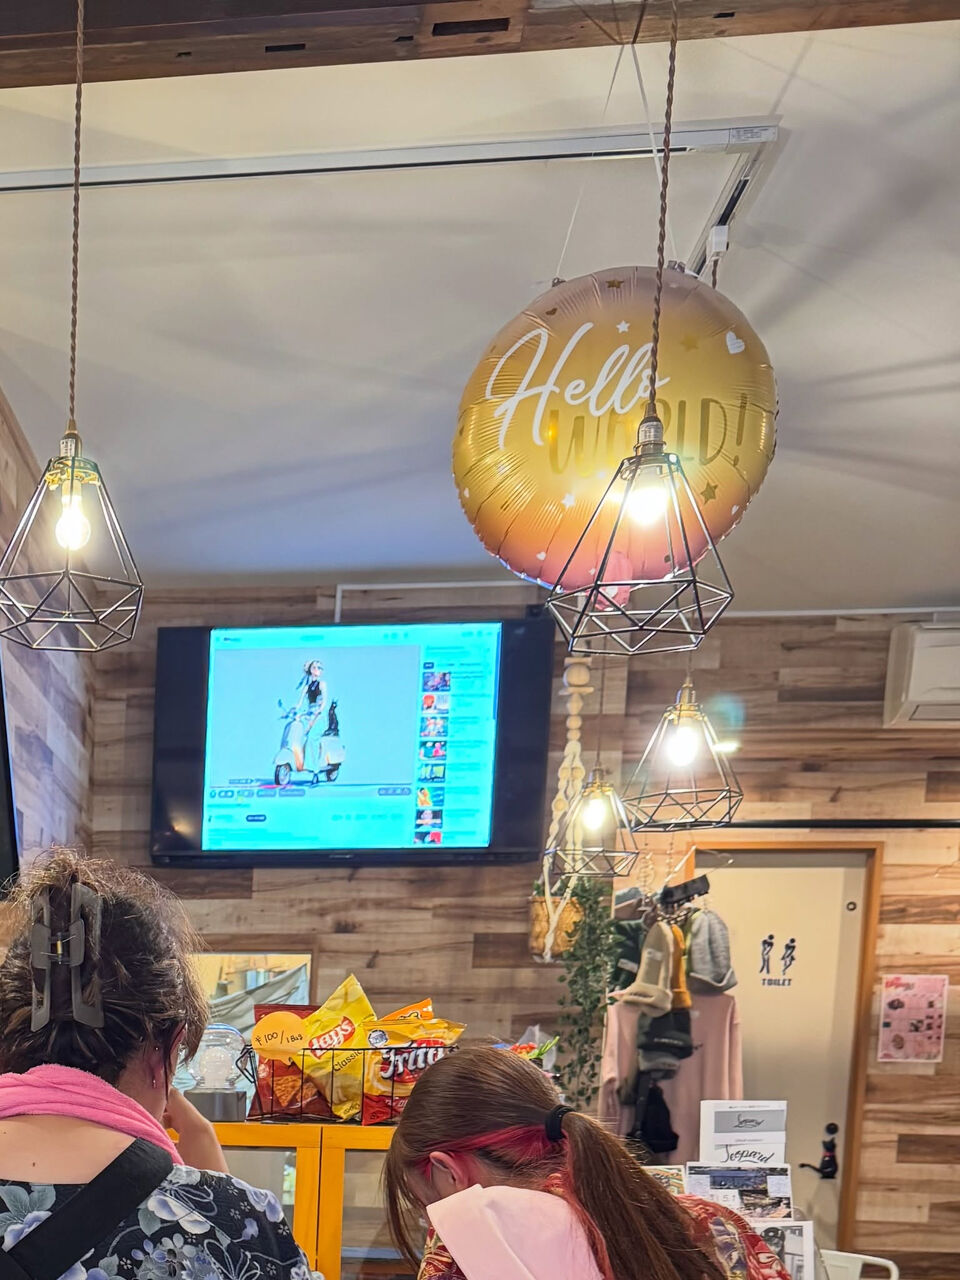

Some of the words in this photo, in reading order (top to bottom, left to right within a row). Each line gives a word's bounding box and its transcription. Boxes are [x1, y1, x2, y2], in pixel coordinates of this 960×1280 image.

[485, 322, 671, 450] Hello
[761, 978, 793, 987] TOILET
[333, 1050, 363, 1072] Classic
